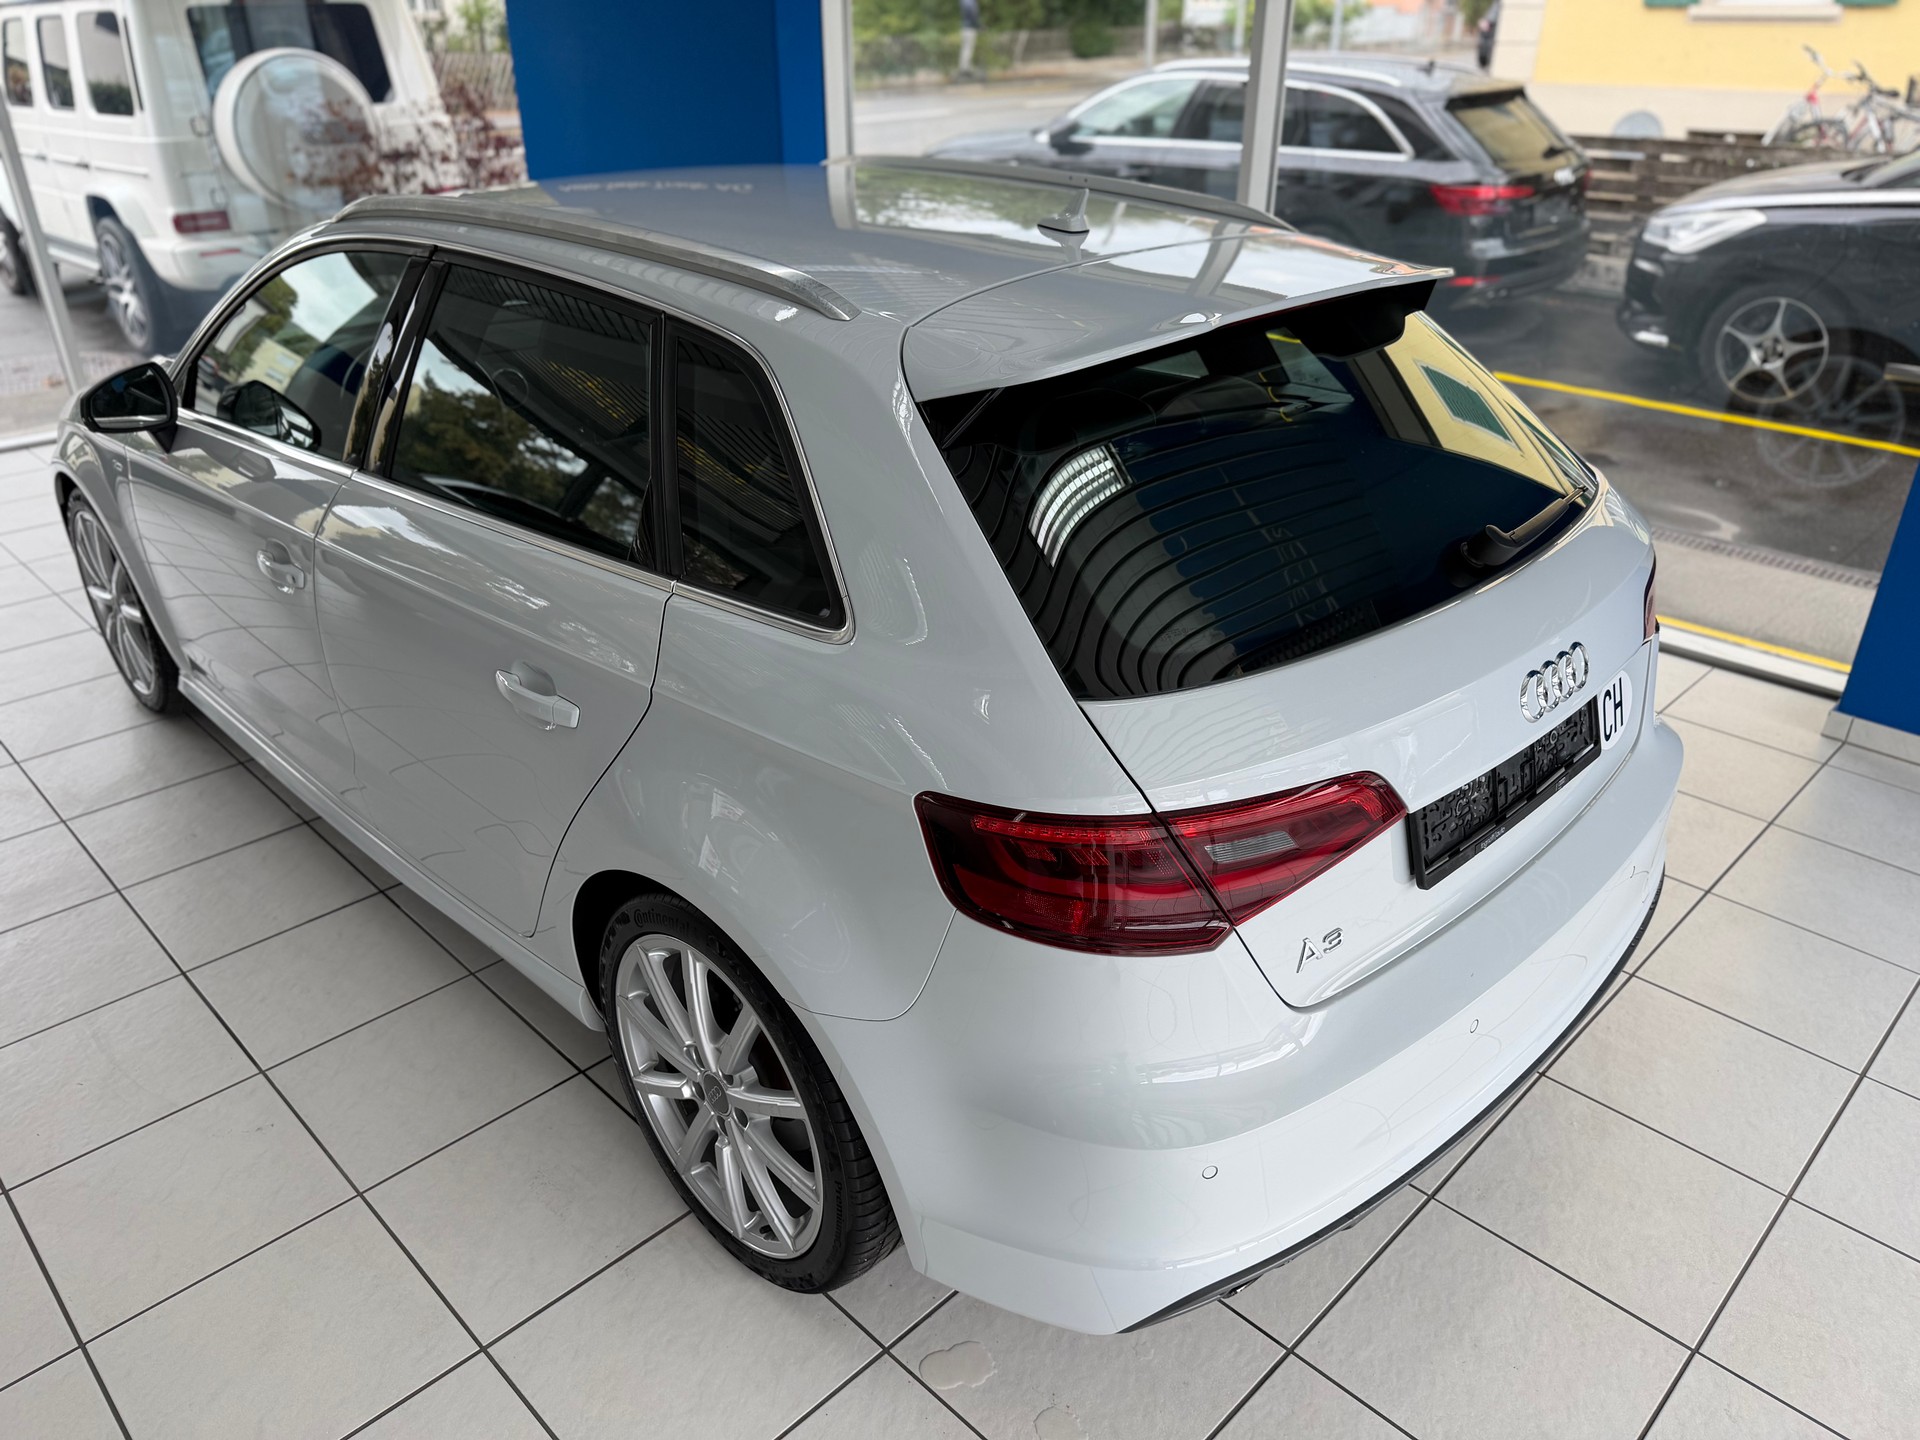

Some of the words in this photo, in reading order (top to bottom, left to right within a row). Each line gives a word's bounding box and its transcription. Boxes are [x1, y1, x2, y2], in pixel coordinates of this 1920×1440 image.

[1603, 678, 1624, 742] CH
[635, 909, 690, 935] Continental
[1296, 927, 1344, 973] A3
